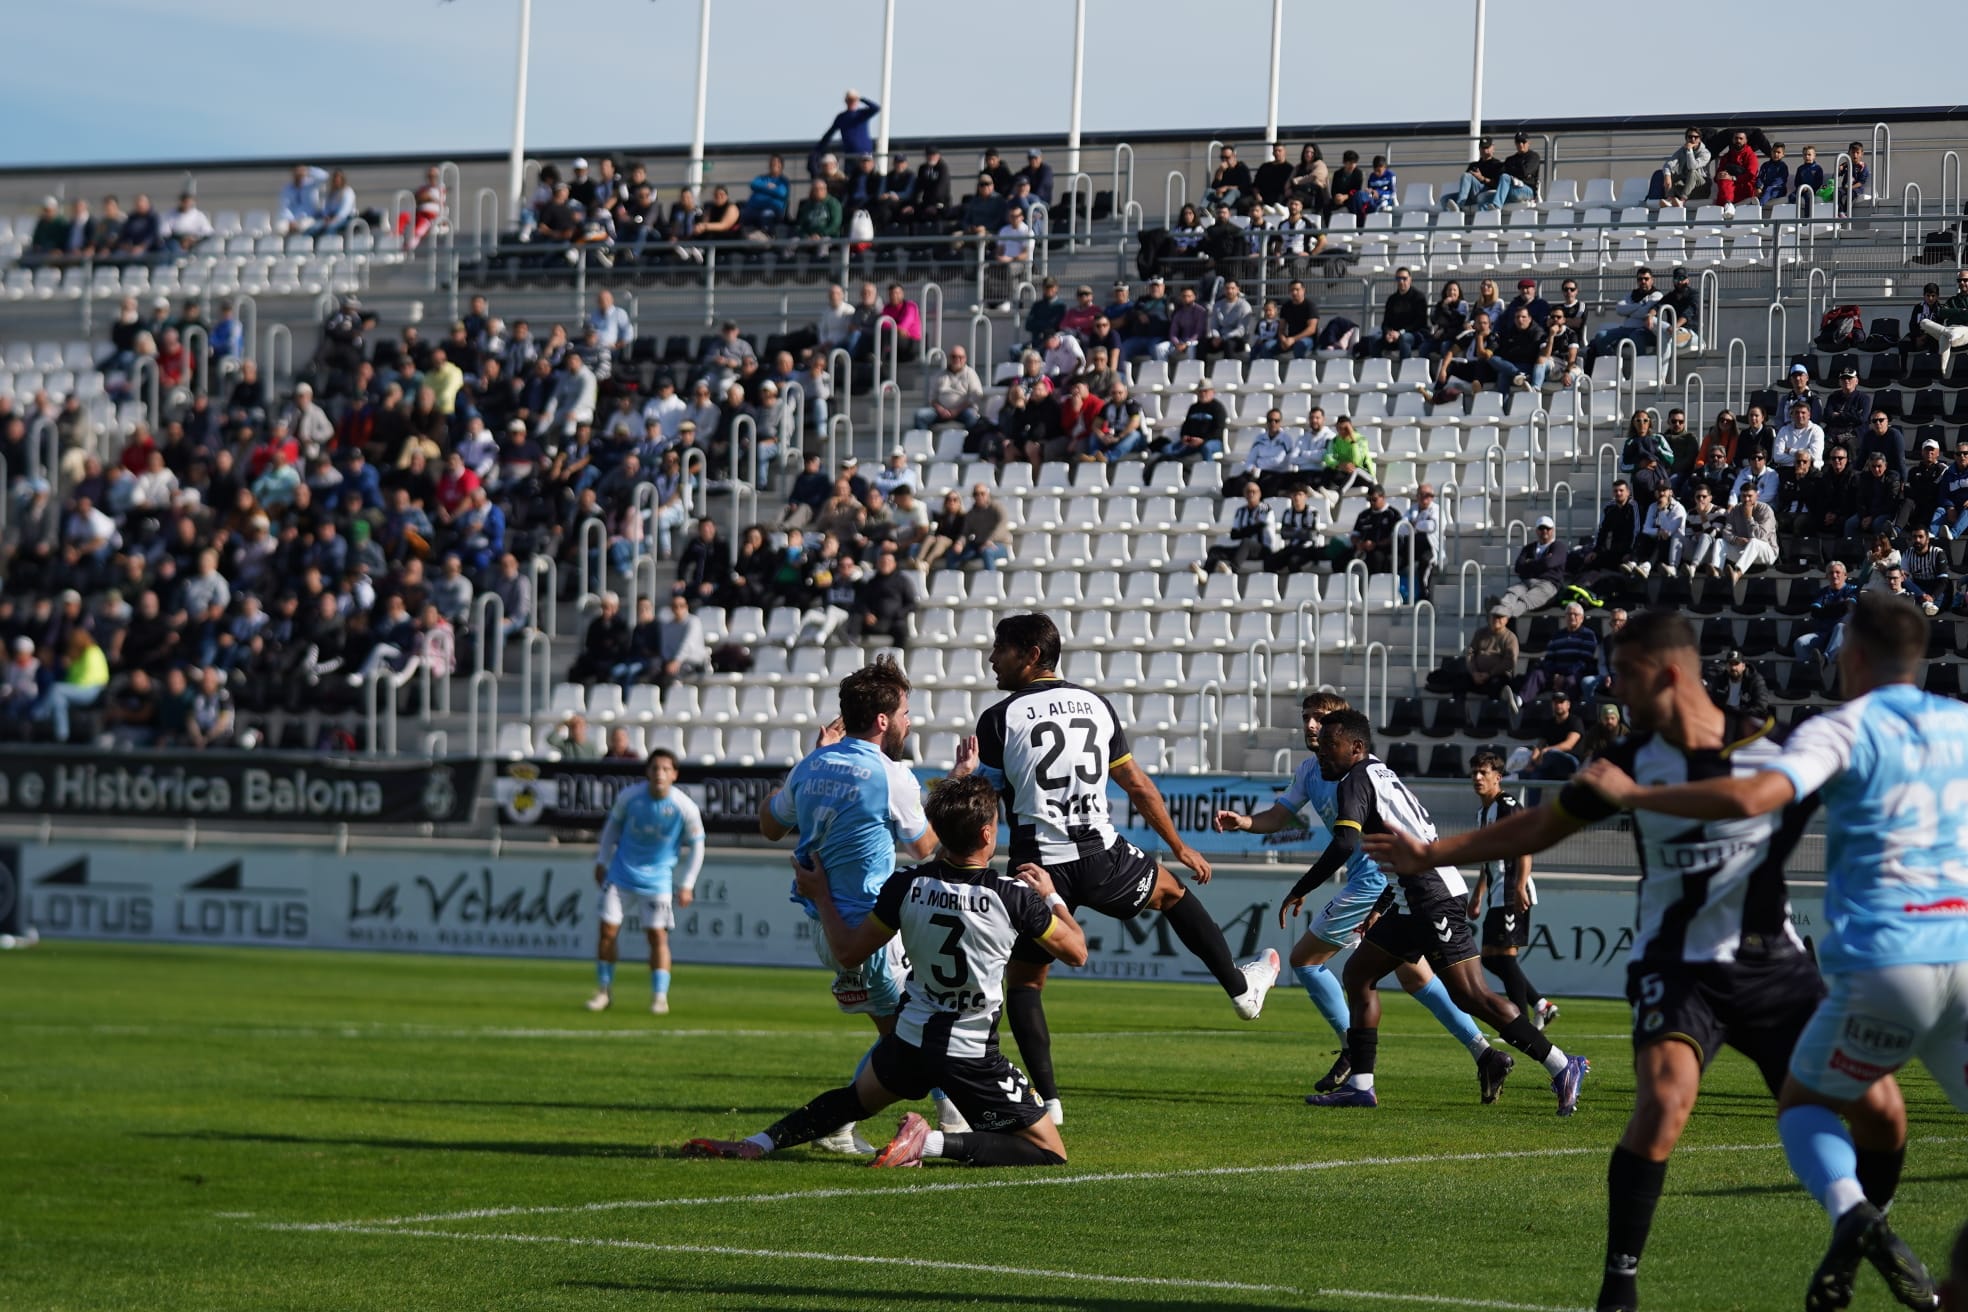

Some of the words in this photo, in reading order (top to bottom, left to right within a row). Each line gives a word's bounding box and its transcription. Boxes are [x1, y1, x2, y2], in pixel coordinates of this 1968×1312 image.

[1026, 706, 1043, 720] J.
[1049, 700, 1094, 716] ALGAR
[1030, 718, 1103, 791] 23
[19, 771, 44, 799] e
[56, 763, 231, 809] Histórica
[243, 768, 383, 815] Balona
[803, 778, 860, 802] ALBERTO
[26, 893, 154, 933] LOTUS
[348, 870, 399, 921] La
[927, 889, 990, 913] MORILLO
[178, 896, 310, 938] LOTUS
[928, 913, 970, 988] 3
[1641, 973, 1665, 1005] 5
